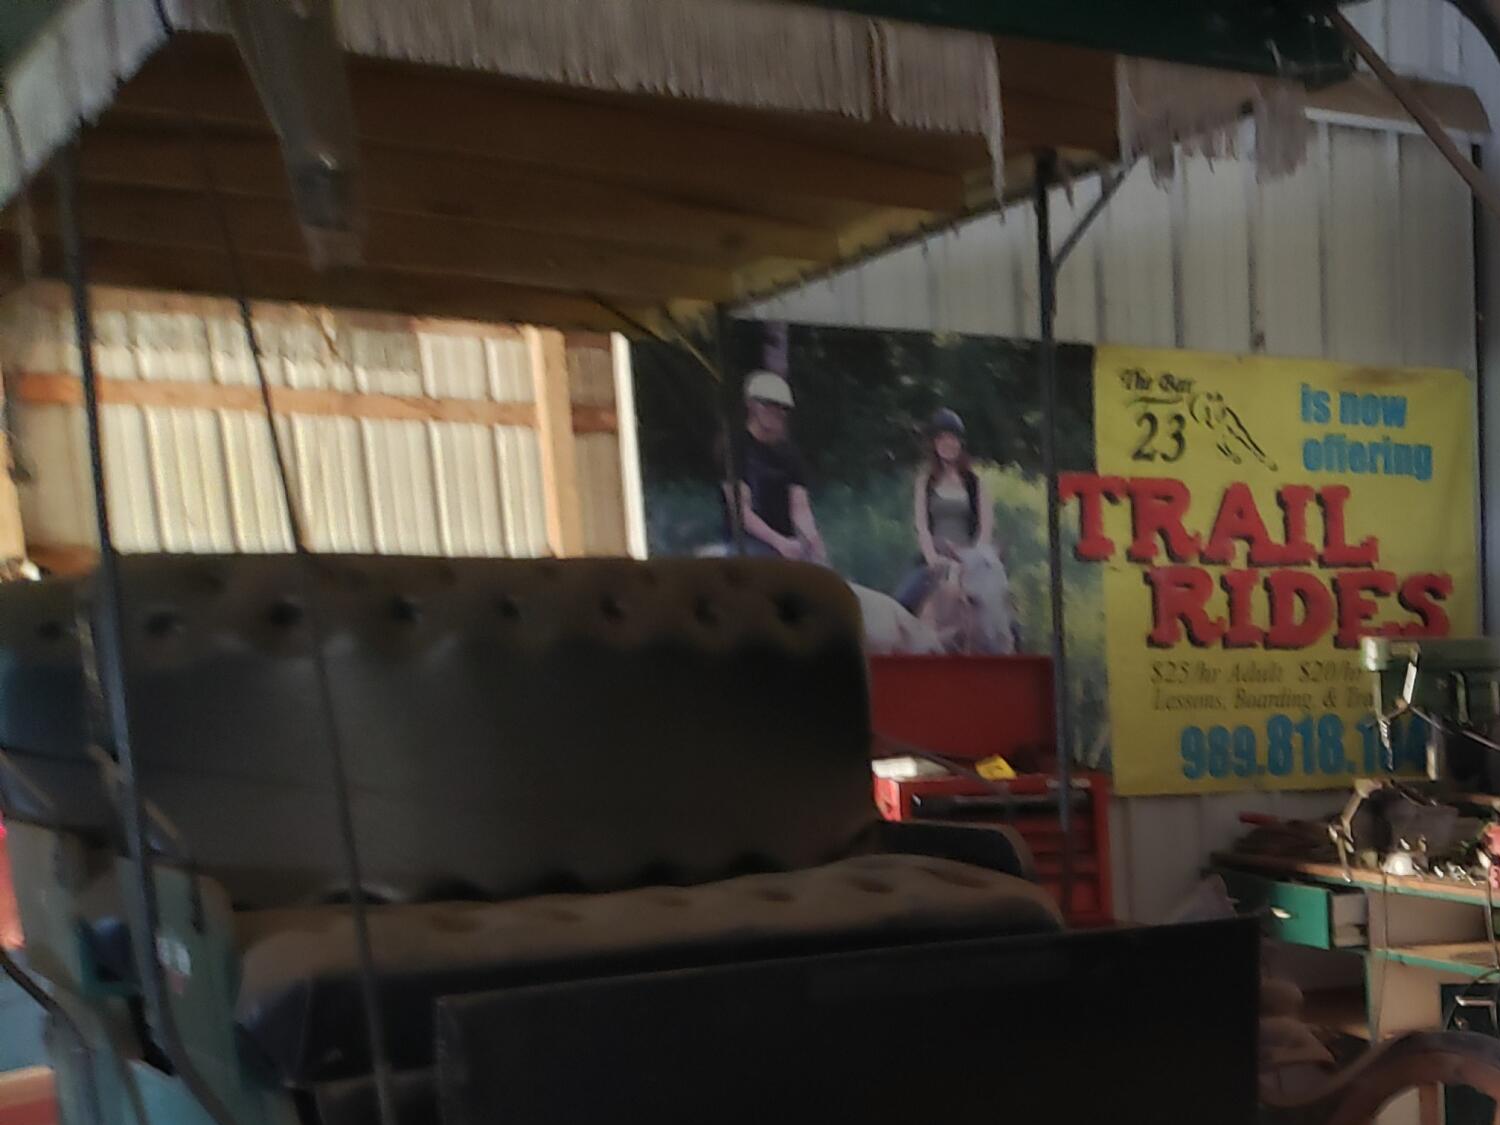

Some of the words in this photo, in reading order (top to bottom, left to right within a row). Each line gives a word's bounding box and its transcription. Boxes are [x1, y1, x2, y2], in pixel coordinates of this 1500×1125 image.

[1300, 382, 1331, 424] is
[1339, 389, 1408, 429] now
[1131, 411, 1188, 463] 23
[1303, 432, 1434, 482] offering
[1057, 471, 1381, 569] TRAIL
[1143, 566, 1455, 650] RIDES
